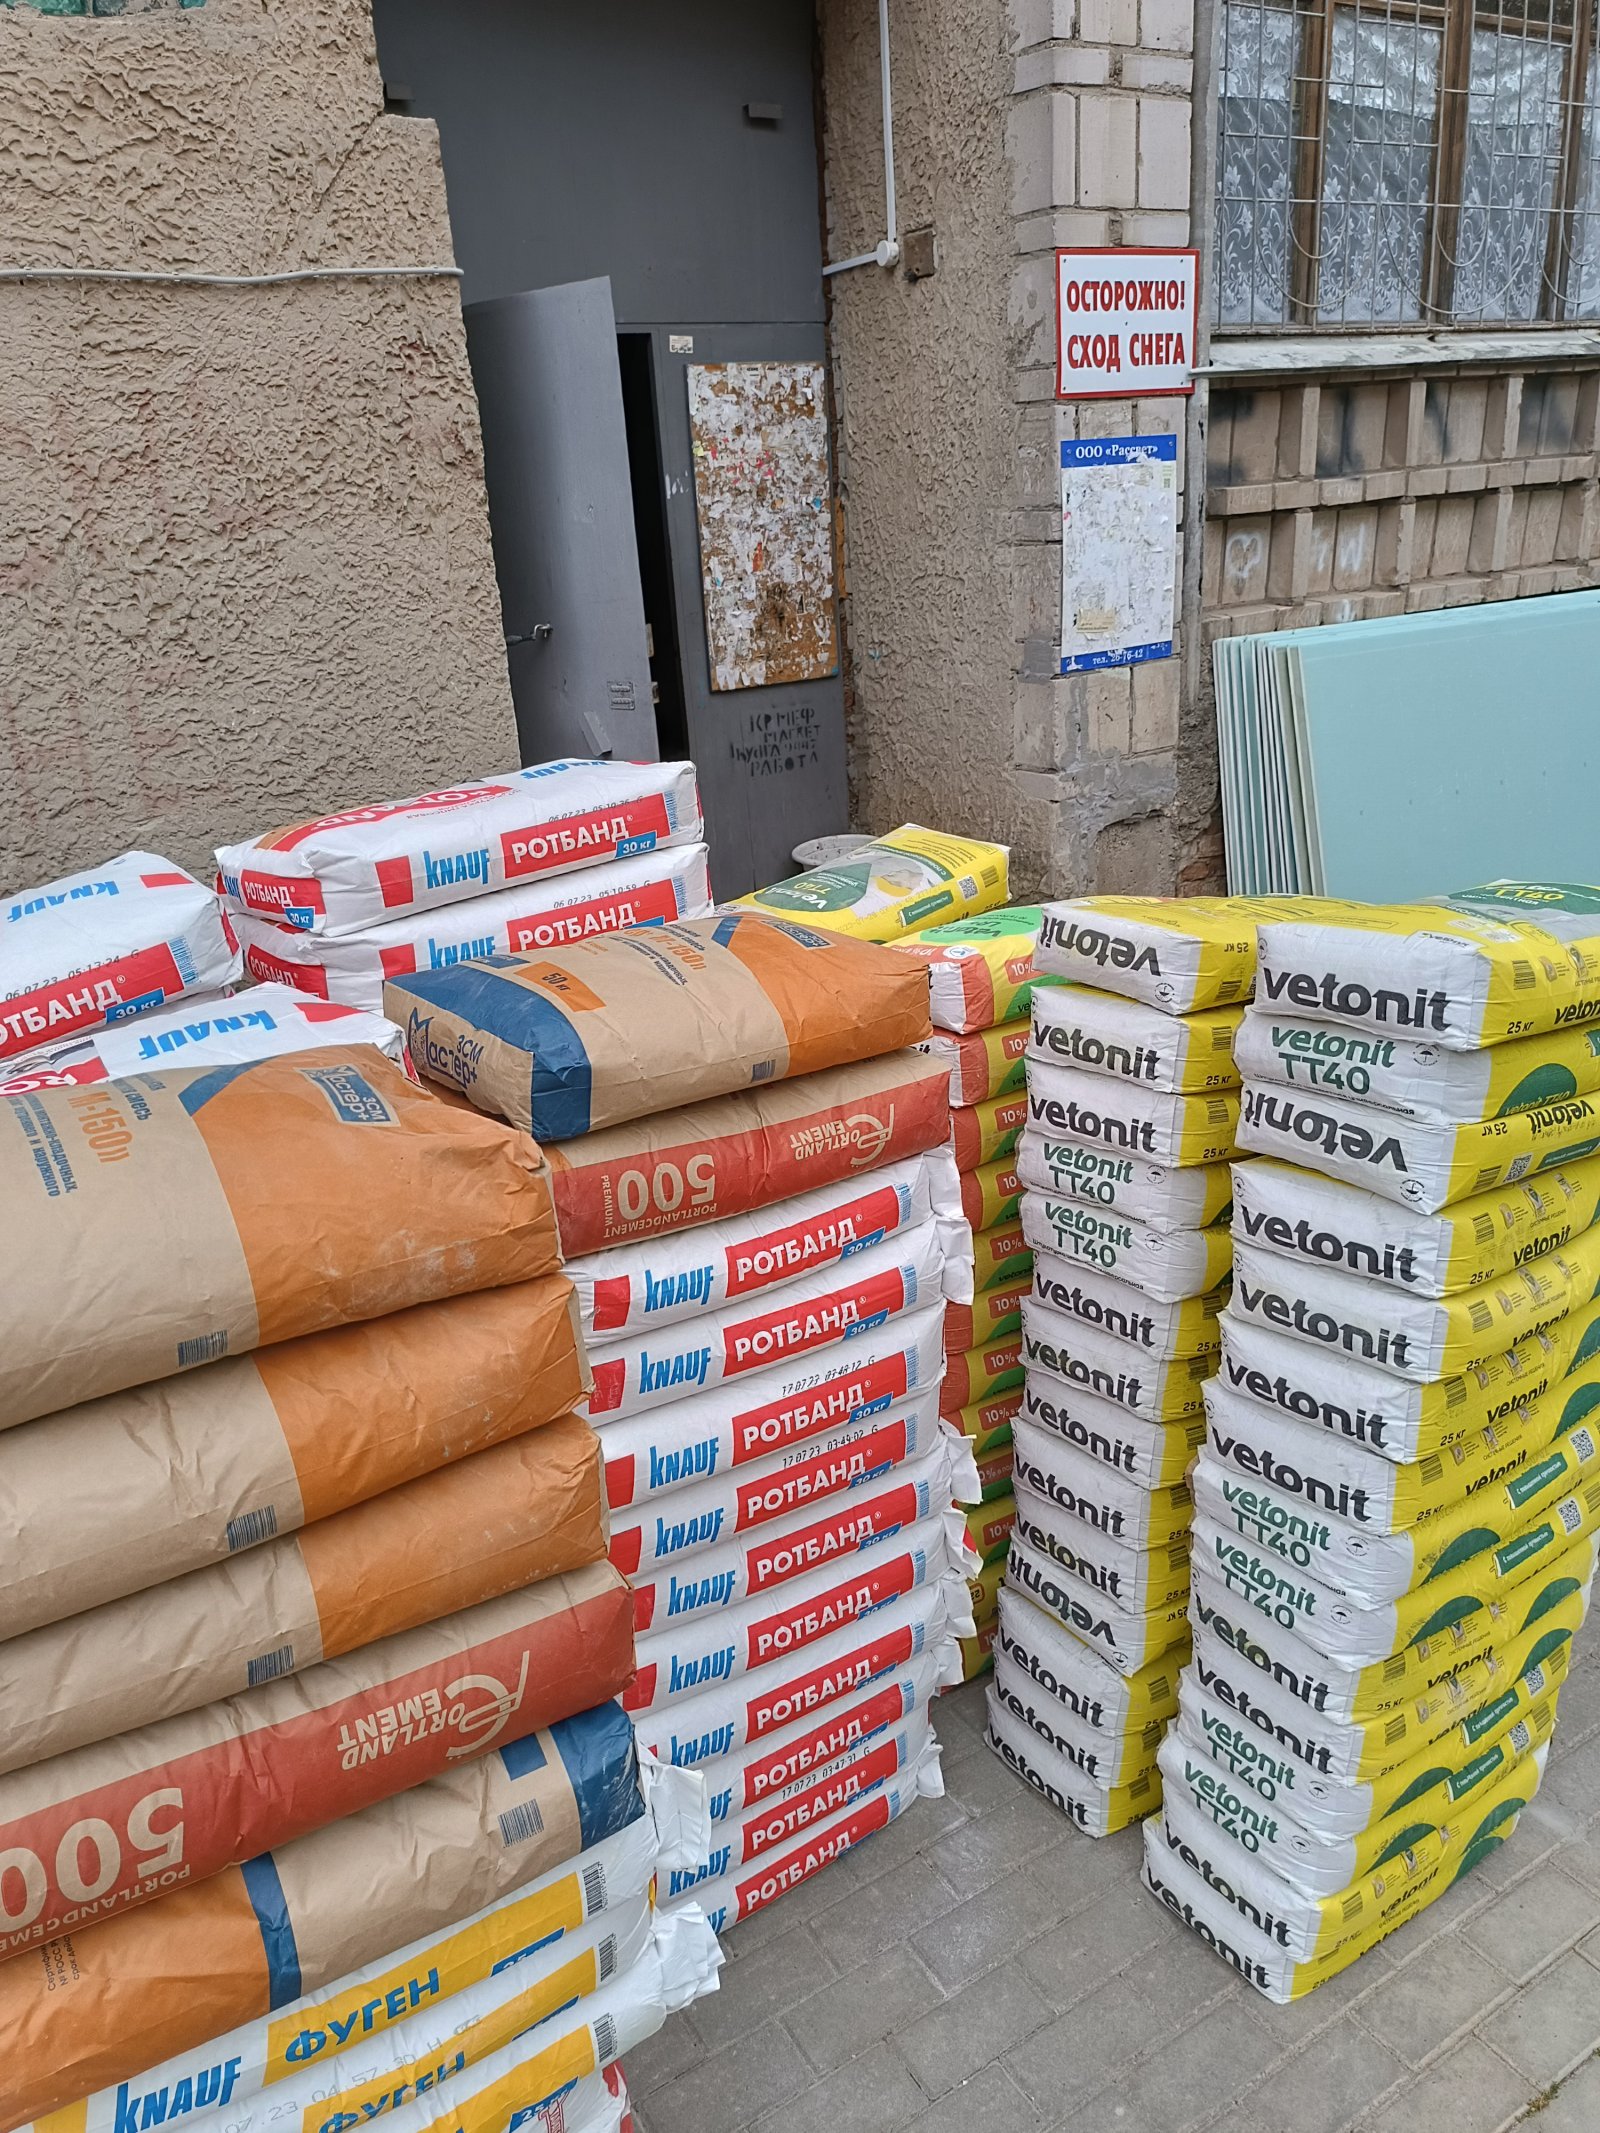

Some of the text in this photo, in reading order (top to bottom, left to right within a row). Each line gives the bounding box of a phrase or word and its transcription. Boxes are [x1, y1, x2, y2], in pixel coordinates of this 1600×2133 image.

[1066, 279, 1186, 313] ОСТОРОЖНО!
[1067, 332, 1186, 373] СХОД СНЕГА
[1075, 445, 1103, 459] ООО
[423, 849, 490, 889] KNAUF
[510, 816, 630, 865] РОТБАНД
[622, 839, 652, 854] 30 кг
[7, 881, 120, 922] KNAUF
[244, 881, 293, 907] РОТБАНД
[290, 913, 300, 924] 30
[428, 936, 496, 970] KNAUF
[518, 903, 637, 951] РОТБАНД
[1040, 915, 1162, 977] vetonit
[115, 999, 158, 1020] 30 кг
[1263, 967, 1452, 1032] vetonit
[1506, 1020, 1534, 1035] 25 кг
[139, 1010, 278, 1060] KNAUF
[1032, 1020, 1161, 1082] vetonit
[1271, 1026, 1397, 1069] vetonit
[1205, 1074, 1220, 1085] 25
[1278, 1052, 1371, 1095] TT40
[1030, 1094, 1158, 1154] vetonit
[1243, 1089, 1409, 1173] vetonit
[1526, 1099, 1595, 1136] vetonit
[1043, 1142, 1134, 1184] vetonit
[1048, 1164, 1116, 1205] TT40
[1203, 1148, 1217, 1159] 25
[601, 1174, 614, 1227] PREMIUM
[616, 1154, 716, 1221] 500
[603, 1203, 718, 1240] PORTLANDCEMENT
[846, 1235, 879, 1257] 30 кг
[997, 1237, 1022, 1253] 10%
[1045, 1201, 1133, 1249] vetonit
[1052, 1224, 1117, 1268] TT40
[1241, 1205, 1418, 1283] vetonit
[1513, 1225, 1571, 1267] vetonit
[644, 1217, 857, 1313] KNAUF РОТБАНД
[1469, 1271, 1484, 1285] 25
[850, 1317, 882, 1336] 30 кг
[1035, 1271, 1156, 1348] vetonit
[1239, 1279, 1413, 1369] vetonit
[639, 1300, 860, 1395] KNAUF РОТБАНД
[990, 1352, 1016, 1368] 10%
[1025, 1333, 1143, 1409] vetonit
[1196, 1342, 1210, 1352] 25
[855, 1402, 887, 1421] 30 кг
[985, 1407, 1010, 1424] 10%
[1026, 1389, 1139, 1474] vetonit
[1183, 1401, 1197, 1412] 25
[1225, 1355, 1389, 1449] vetonit
[1486, 1379, 1549, 1425] vetonit
[649, 1383, 866, 1489] KNAUF РОТБАНД
[1440, 1433, 1455, 1446] 25
[1015, 1453, 1126, 1538] vetonit
[1211, 1428, 1372, 1522] vetonit
[1465, 1449, 1527, 1497] vetonit
[654, 1452, 866, 1558] KNAUF РОТБАНД
[1222, 1479, 1331, 1552] vetonit
[1416, 1507, 1432, 1521] 25
[668, 1515, 876, 1617] KNAUF РОТБАНД
[1016, 1511, 1123, 1599] vetonit
[1230, 1506, 1312, 1568] TT40
[1010, 1550, 1117, 1647] vetonit
[1215, 1535, 1317, 1617] vetonit
[1220, 1564, 1296, 1630] TT40
[668, 1587, 873, 1693] KNAUF РОТБАНД
[1196, 1595, 1329, 1713] vetonit
[1000, 1626, 1104, 1728] vetonit
[670, 1659, 872, 1768] KNAUF РОТБАНД
[996, 1675, 1100, 1778] vetonit
[1197, 1656, 1334, 1776] vetonit
[753, 1721, 863, 1796] РОТБАНД
[988, 1725, 1090, 1826] vetonit
[1201, 1708, 1296, 1791] vetonit
[1206, 1735, 1277, 1802] TT40
[1184, 1759, 1279, 1845] vetonit
[1191, 1786, 1259, 1855] TT40
[0, 1787, 184, 1933] 500
[669, 1845, 731, 1896] KNAUF
[751, 1775, 862, 1850] РОТБАНД
[745, 1831, 852, 1911] РОТБАНД
[1164, 1820, 1292, 1948] vetonit
[1146, 1864, 1271, 1990] vetonit
[285, 1967, 440, 2063] ФУГЕН
[113, 2056, 242, 2133] KNAUF
[318, 2051, 466, 2133] ФУГЕН
